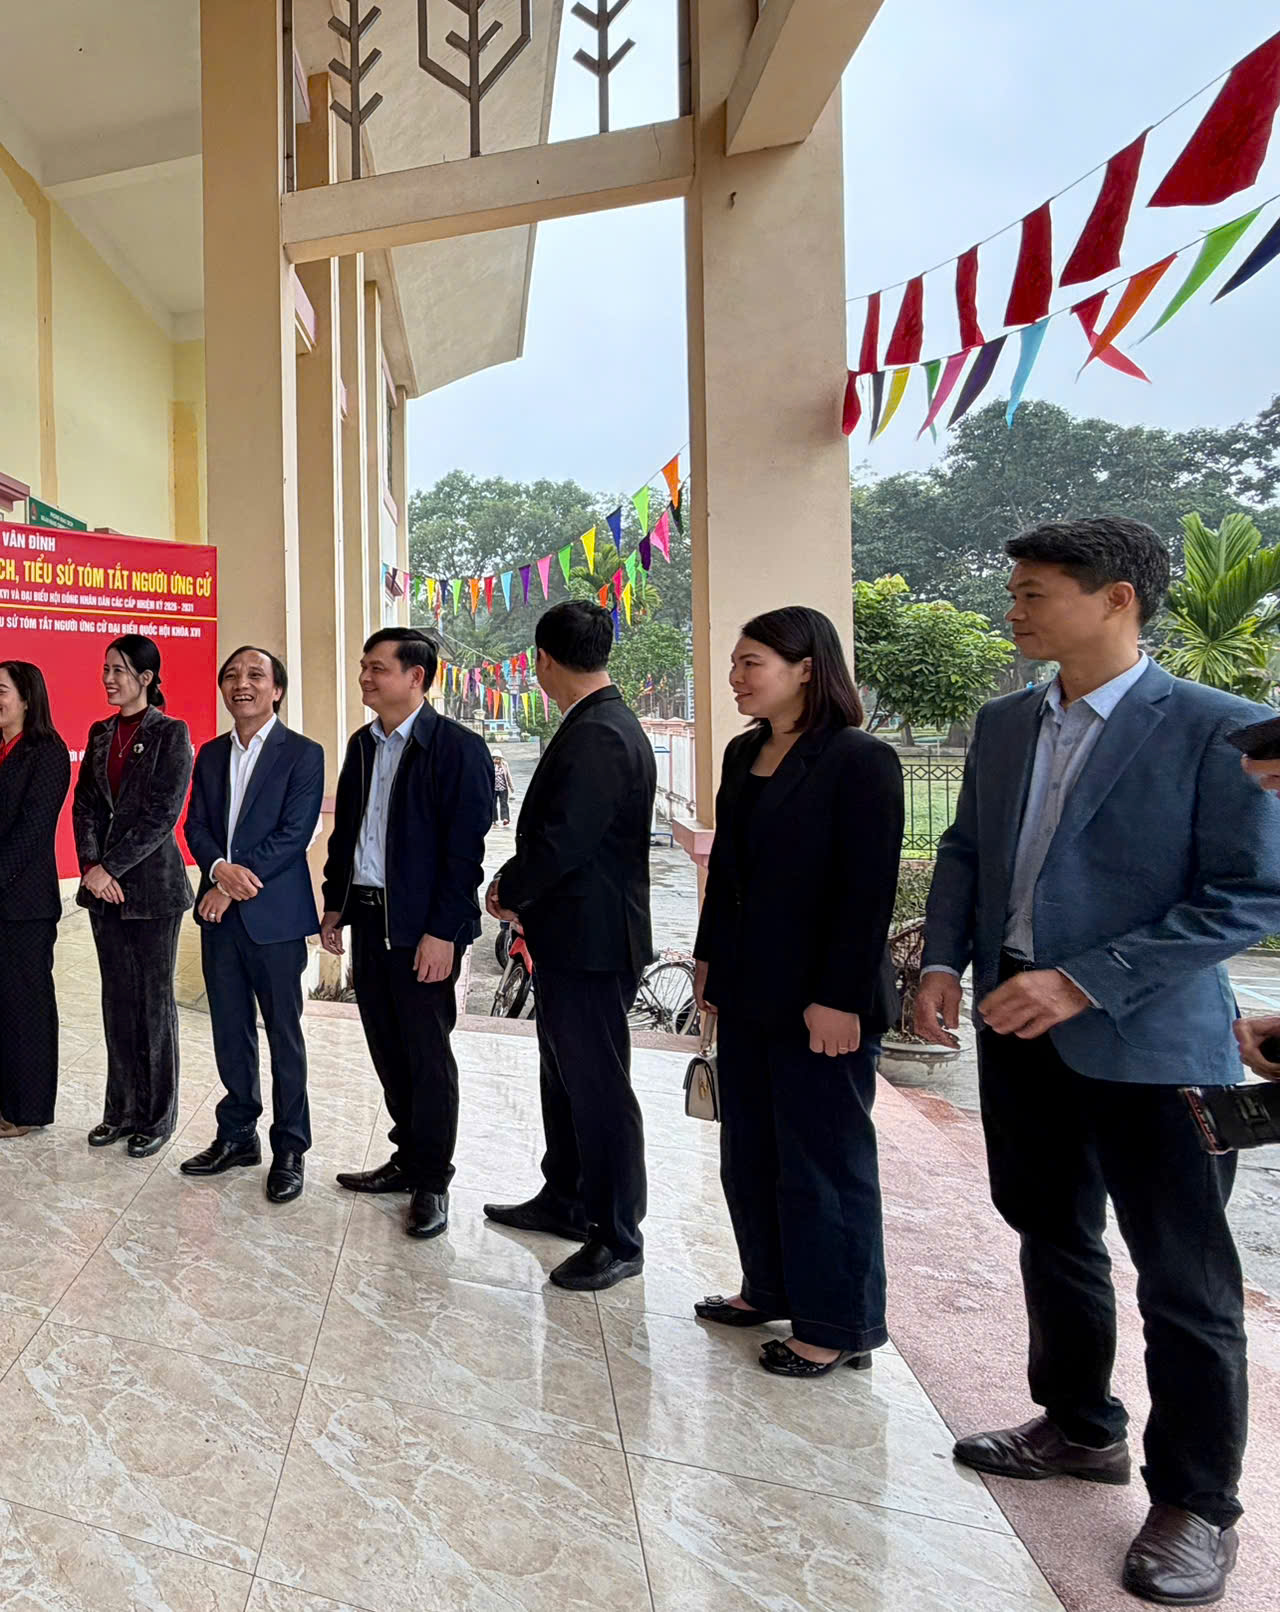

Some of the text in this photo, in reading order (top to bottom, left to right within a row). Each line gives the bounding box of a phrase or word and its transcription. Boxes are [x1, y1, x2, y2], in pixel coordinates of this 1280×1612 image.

[2, 529, 26, 549] VÂN
[28, 533, 56, 552] ĐÌNH
[23, 553, 53, 585] TIỂU
[56, 558, 76, 586] SỬ
[77, 563, 104, 589] TÓM
[107, 563, 130, 591] TẮT
[132, 569, 168, 594] NGƯỜI
[170, 571, 194, 596] ỨNG
[196, 571, 212, 597] CỬ
[6, 613, 19, 628] SỬ
[20, 616, 37, 629] TÓM
[39, 616, 53, 631] TẮT
[54, 618, 78, 632] NGƯỜI
[139, 621, 157, 636] QUỐC
